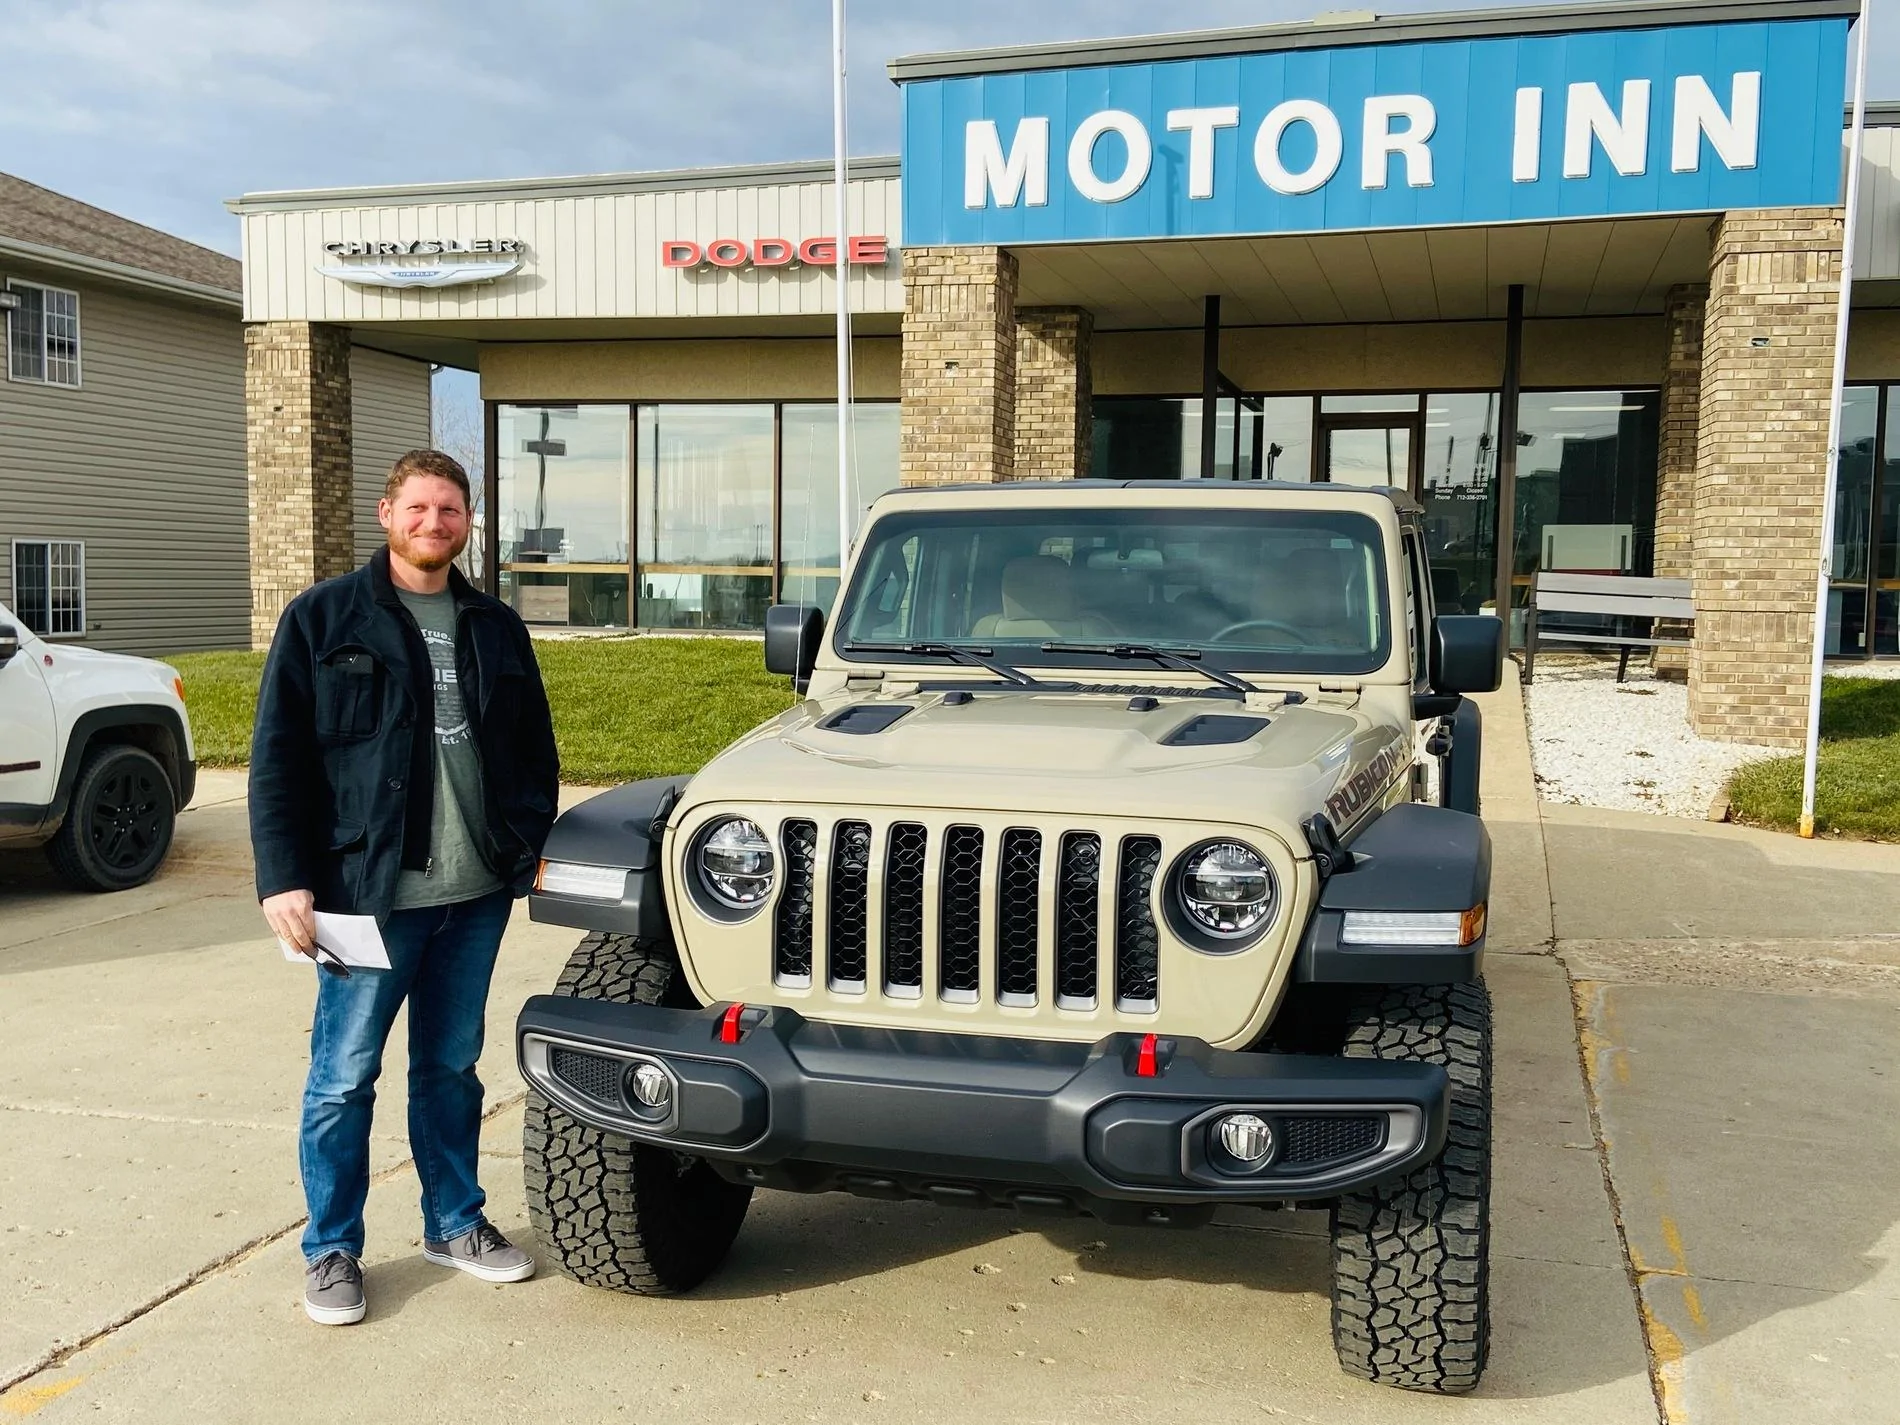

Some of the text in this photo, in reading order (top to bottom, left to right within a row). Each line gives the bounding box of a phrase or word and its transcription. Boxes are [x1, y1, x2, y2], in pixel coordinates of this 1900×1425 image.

[964, 71, 1761, 209] MOTOR INN
[324, 238, 520, 255] CHRYSLER
[662, 235, 889, 268] DODGE
[1325, 745, 1399, 826] RUBICON
